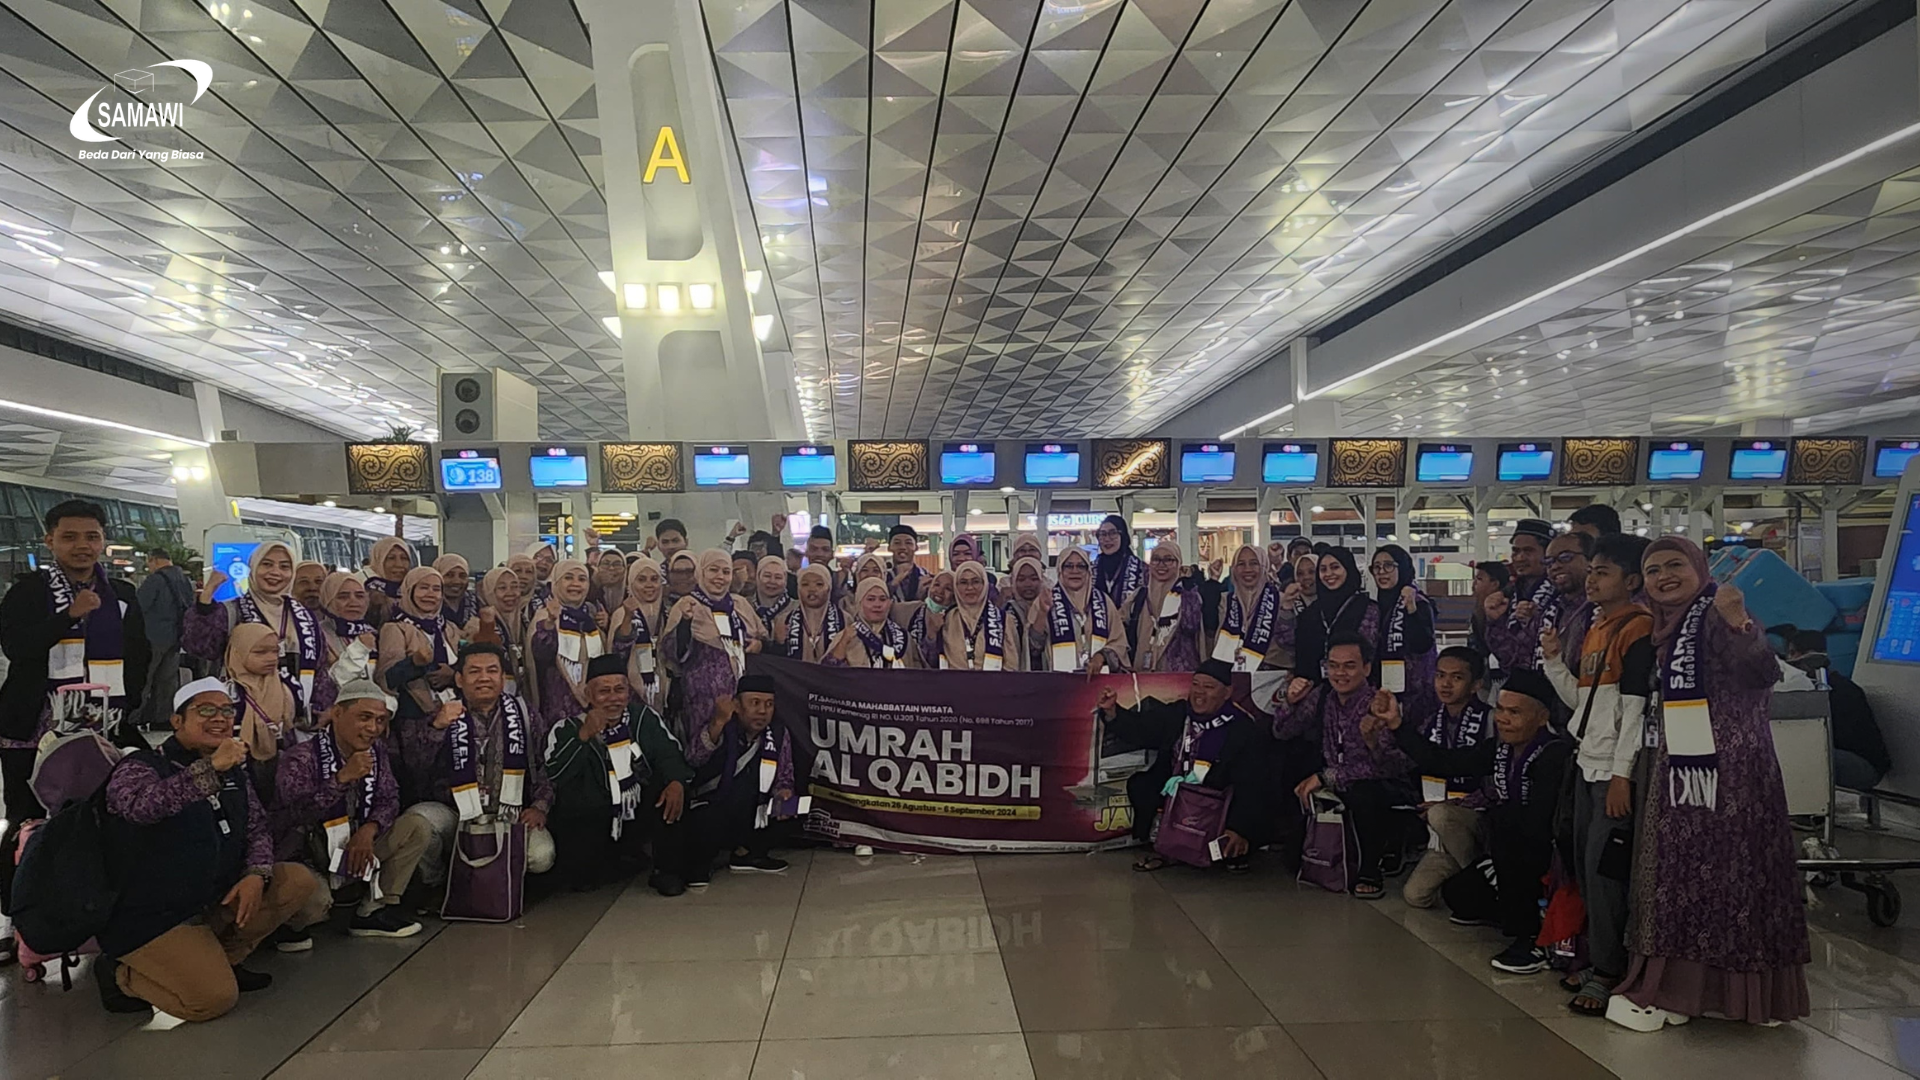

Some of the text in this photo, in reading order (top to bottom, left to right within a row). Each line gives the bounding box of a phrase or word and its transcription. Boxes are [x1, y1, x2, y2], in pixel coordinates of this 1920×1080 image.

[643, 126, 691, 183] A
[468, 469, 494, 483] 138
[1053, 587, 1070, 636] TRAVEL
[1257, 593, 1274, 644] TRAVEL
[1684, 641, 1696, 662] Dari
[921, 705, 953, 714] WISATA
[991, 718, 1014, 726] Tahun
[809, 715, 973, 762] UMRAH
[809, 750, 1042, 798] AL QABIDH
[902, 803, 937, 814] Agustus
[950, 806, 996, 816] September
[996, 807, 1017, 816] 2024
